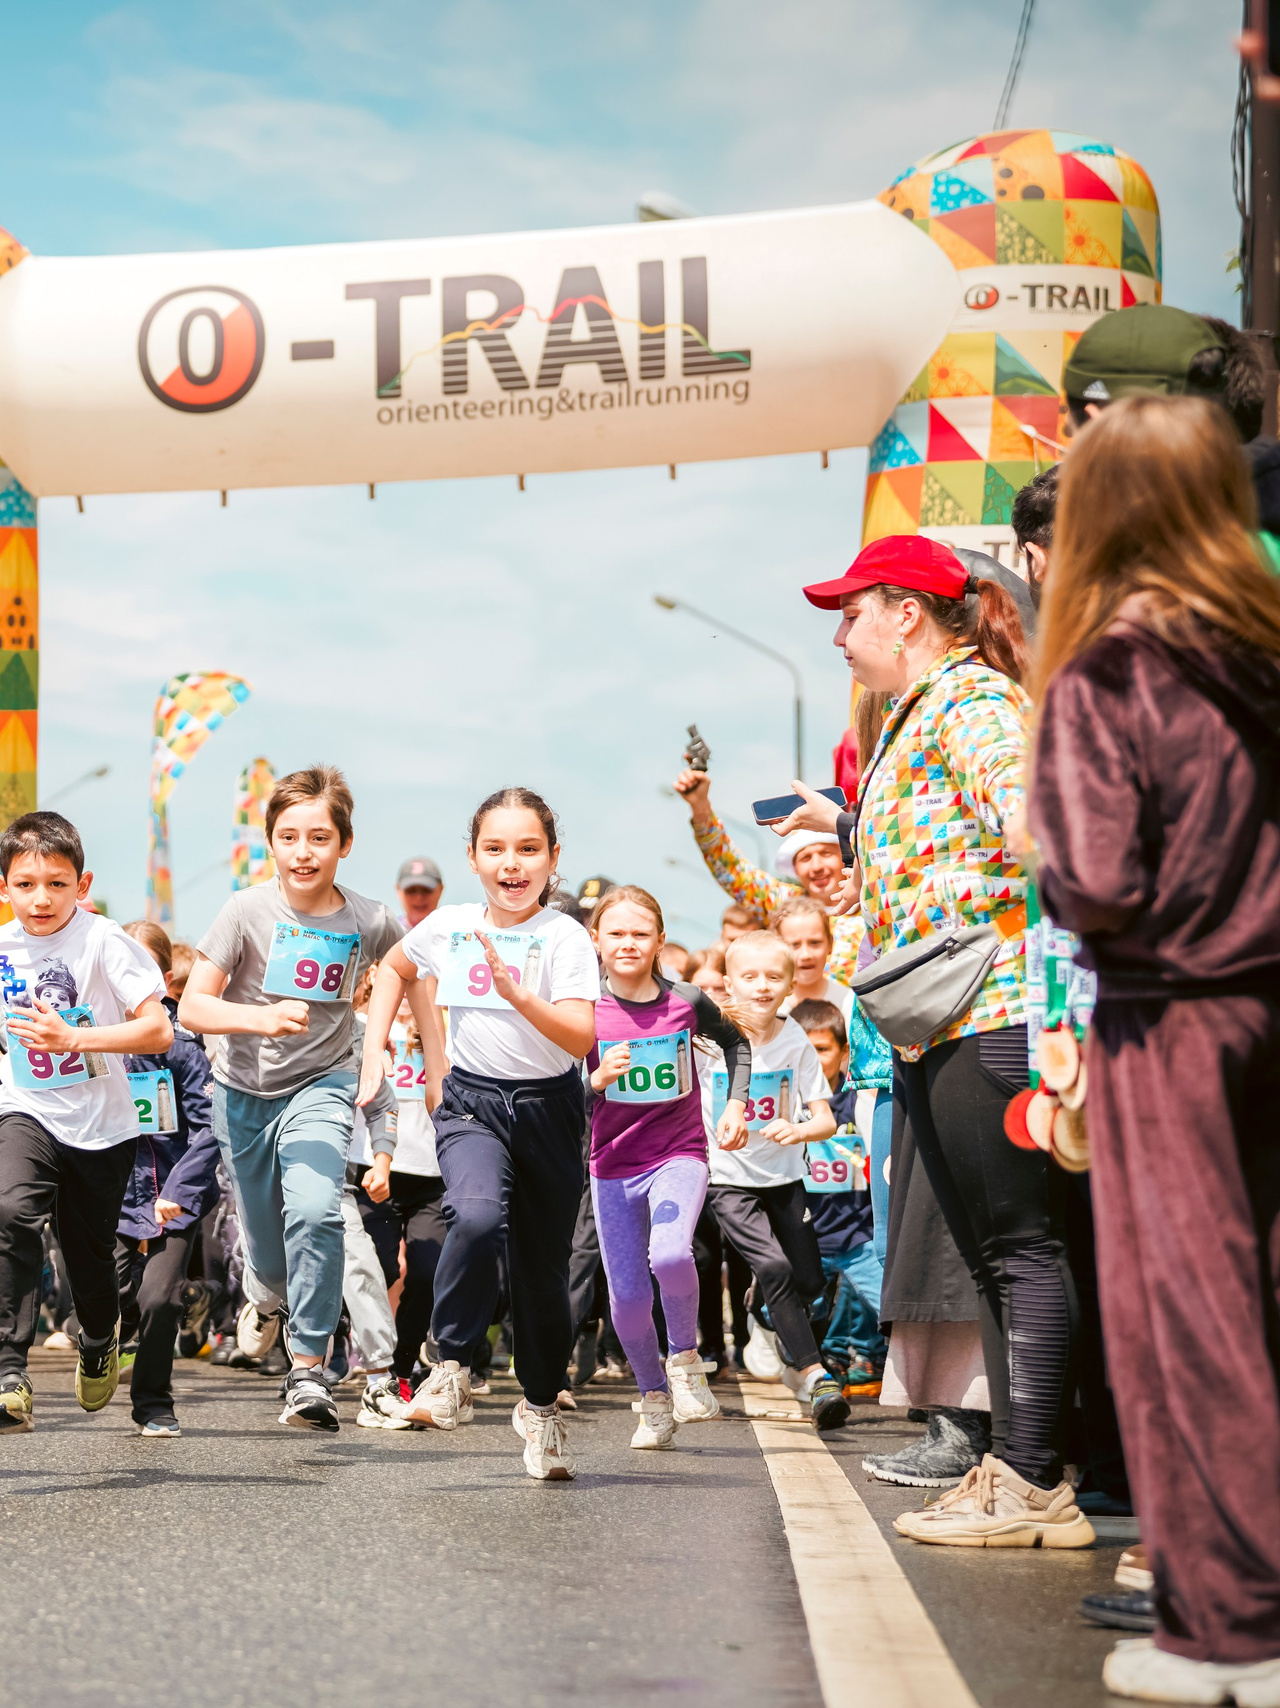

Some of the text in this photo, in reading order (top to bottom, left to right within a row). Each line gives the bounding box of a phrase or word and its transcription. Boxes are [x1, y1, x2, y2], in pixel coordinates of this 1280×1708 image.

[377, 376, 751, 426] orienteering&trailrunning
[294, 959, 344, 992] 98
[28, 1048, 84, 1079] 92
[618, 1062, 676, 1092] 106
[812, 1160, 848, 1183] 69
